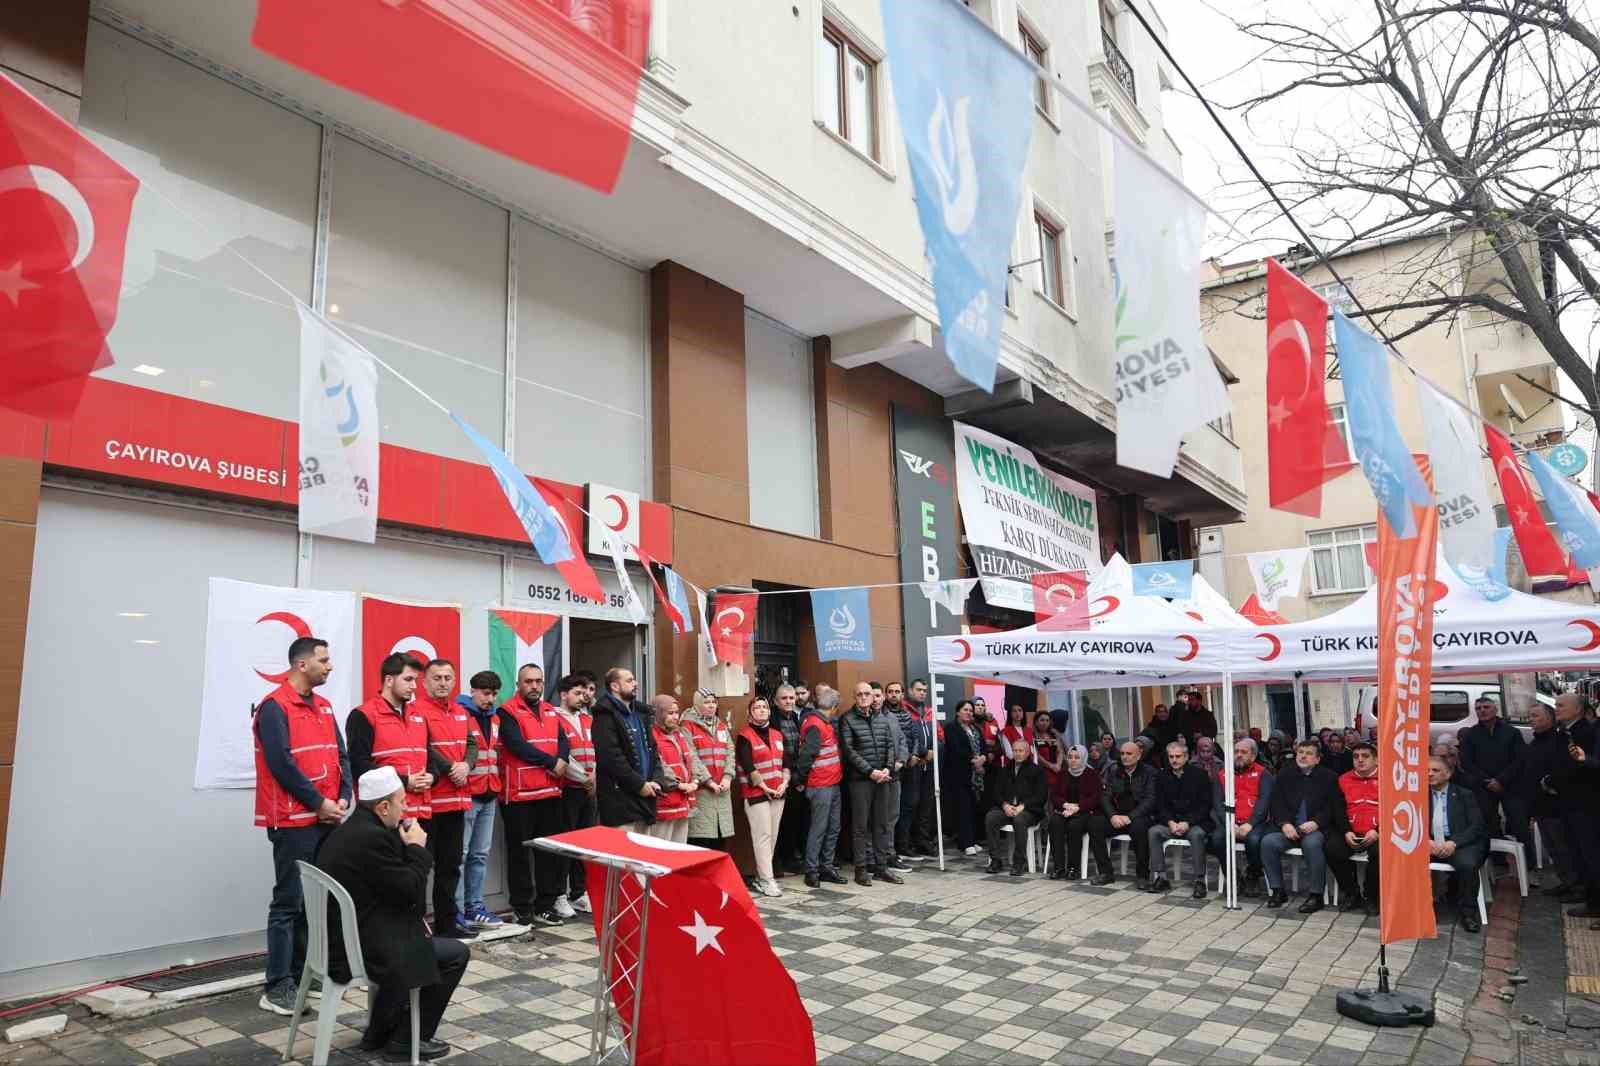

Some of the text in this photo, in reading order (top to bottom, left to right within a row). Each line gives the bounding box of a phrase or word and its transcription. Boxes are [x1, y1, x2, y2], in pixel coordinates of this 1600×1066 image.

[105, 440, 212, 473] ÇAYIROVA
[217, 461, 287, 487] ŞUBESİ
[980, 484, 1022, 518] TEKNİK
[1023, 502, 1049, 530] SERV
[528, 584, 561, 601] 0552
[610, 594, 624, 608] 56
[985, 641, 1155, 656] TÜRK KIZILAY ÇAYIROVA
[1301, 635, 1350, 652] TÜRK
[1433, 630, 1538, 650] ÇAYIROVA
[1391, 572, 1416, 792] ÇAYIROVA
